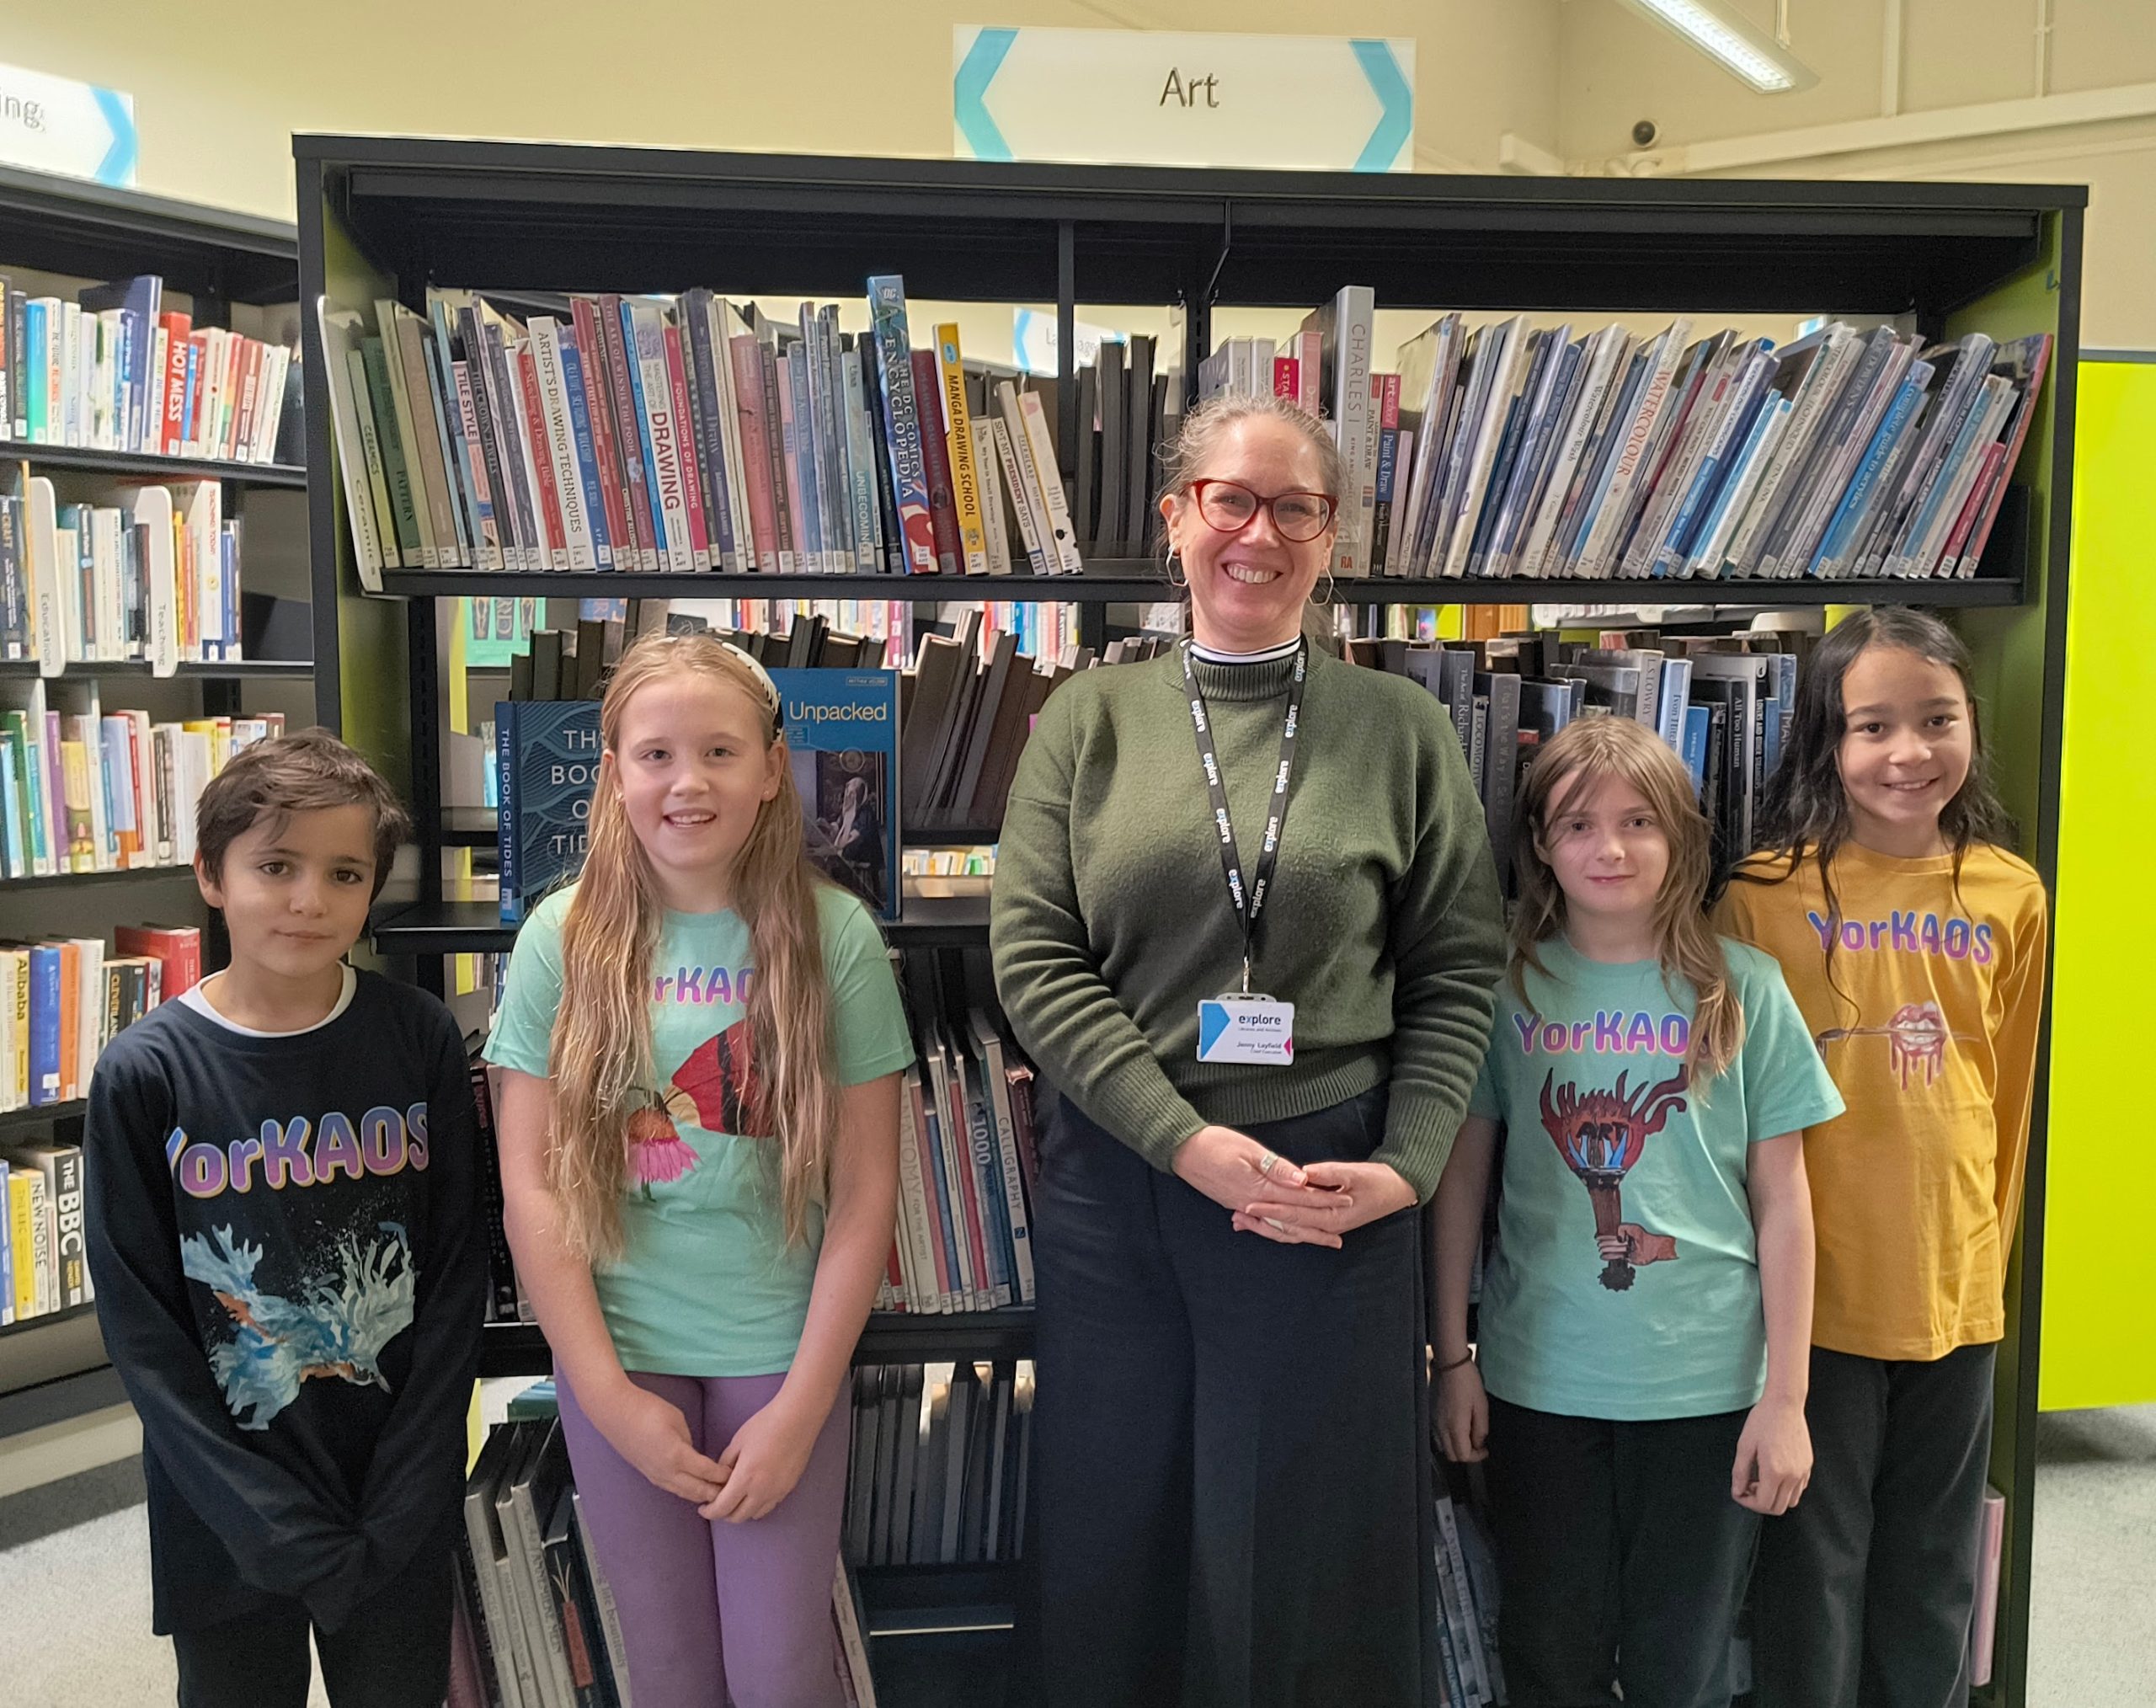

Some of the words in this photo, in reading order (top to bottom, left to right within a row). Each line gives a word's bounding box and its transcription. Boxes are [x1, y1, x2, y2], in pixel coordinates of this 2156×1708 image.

[1160, 67, 1219, 108] Art
[606, 304, 614, 322] THE
[610, 327, 618, 344] ART
[173, 341, 186, 377] HOT
[538, 333, 557, 386] ARTIST'S
[613, 349, 621, 360] OF
[1348, 324, 1366, 411] CHARLES
[456, 371, 469, 398] TILE
[616, 366, 627, 402] WINNIE
[899, 358, 910, 388] THE
[1281, 372, 1289, 398] STAR
[169, 378, 184, 421] MESS
[903, 395, 914, 414] DC
[947, 375, 961, 415] MANGA
[1575, 385, 1604, 437] Watercolour
[462, 400, 477, 438] STYLE
[547, 388, 567, 451] DRAWING
[622, 405, 631, 423] THE
[675, 382, 690, 447] FOUNDATIONS
[883, 338, 913, 499] ENCYCLOPEDIA
[1615, 371, 1672, 477] WATERCOLOUR
[364, 425, 379, 475] CERAMICS
[624, 426, 635, 452] POOH
[684, 451, 691, 463] OF
[905, 422, 921, 478] COMICS
[953, 418, 968, 471] DRAWING
[1382, 435, 1393, 457] Paint
[1567, 440, 1583, 462] Wash
[1874, 434, 1893, 459] guide
[652, 412, 680, 510] DRAWING
[1381, 460, 1392, 468] &
[1869, 460, 1881, 471] to
[557, 453, 581, 533] TECHNIQUES
[686, 466, 698, 509] DRAWING
[961, 473, 976, 517] SCHOOL
[1001, 443, 1011, 456] MY
[1006, 458, 1023, 504] PRESIDENT
[1018, 506, 1031, 527] SAYS
[1380, 470, 1390, 494] Draw
[1849, 471, 1875, 509] acrylics
[356, 479, 376, 575] Ceramics
[40, 593, 51, 667] Education
[157, 605, 166, 666] Teaching
[1294, 651, 1305, 681] explore
[789, 701, 887, 724] Unpacked
[1191, 699, 1205, 732] explore
[1500, 684, 1512, 721] That's
[1672, 694, 1681, 716] Ivon
[1755, 699, 1764, 720] LOVERS
[1285, 704, 1298, 738] explore
[1457, 704, 1469, 746] Richard
[1668, 718, 1679, 746] Hitch
[1755, 722, 1764, 735] AND
[501, 728, 510, 757] THE
[1496, 747, 1509, 771] Way
[502, 763, 511, 805] BOOK
[1203, 752, 1218, 786] explore
[1275, 760, 1289, 793] explore
[503, 812, 512, 830] OF
[572, 800, 590, 819] O
[1216, 808, 1231, 844] explore
[1265, 816, 1278, 852] explore
[504, 837, 512, 878] TIDES
[1228, 869, 1243, 910] explore
[1250, 878, 1266, 918] explore
[1806, 910, 1992, 964] YorKAOS
[17, 958, 27, 1020] Alibaba
[654, 966, 755, 1006] rKAO
[1239, 1014, 1281, 1026] explore
[1513, 1010, 1690, 1054] YorKAO
[971, 1118, 992, 1166] 1000
[63, 1160, 74, 1190] THE
[998, 1117, 1021, 1210] CALLIGRAPHY
[32, 1183, 44, 1219] NEW
[912, 1199, 921, 1215] FOR
[58, 1190, 82, 1256] BBC
[915, 1216, 924, 1232] THE
[35, 1220, 46, 1269] NOISE
[916, 1234, 927, 1261] ARTIST
